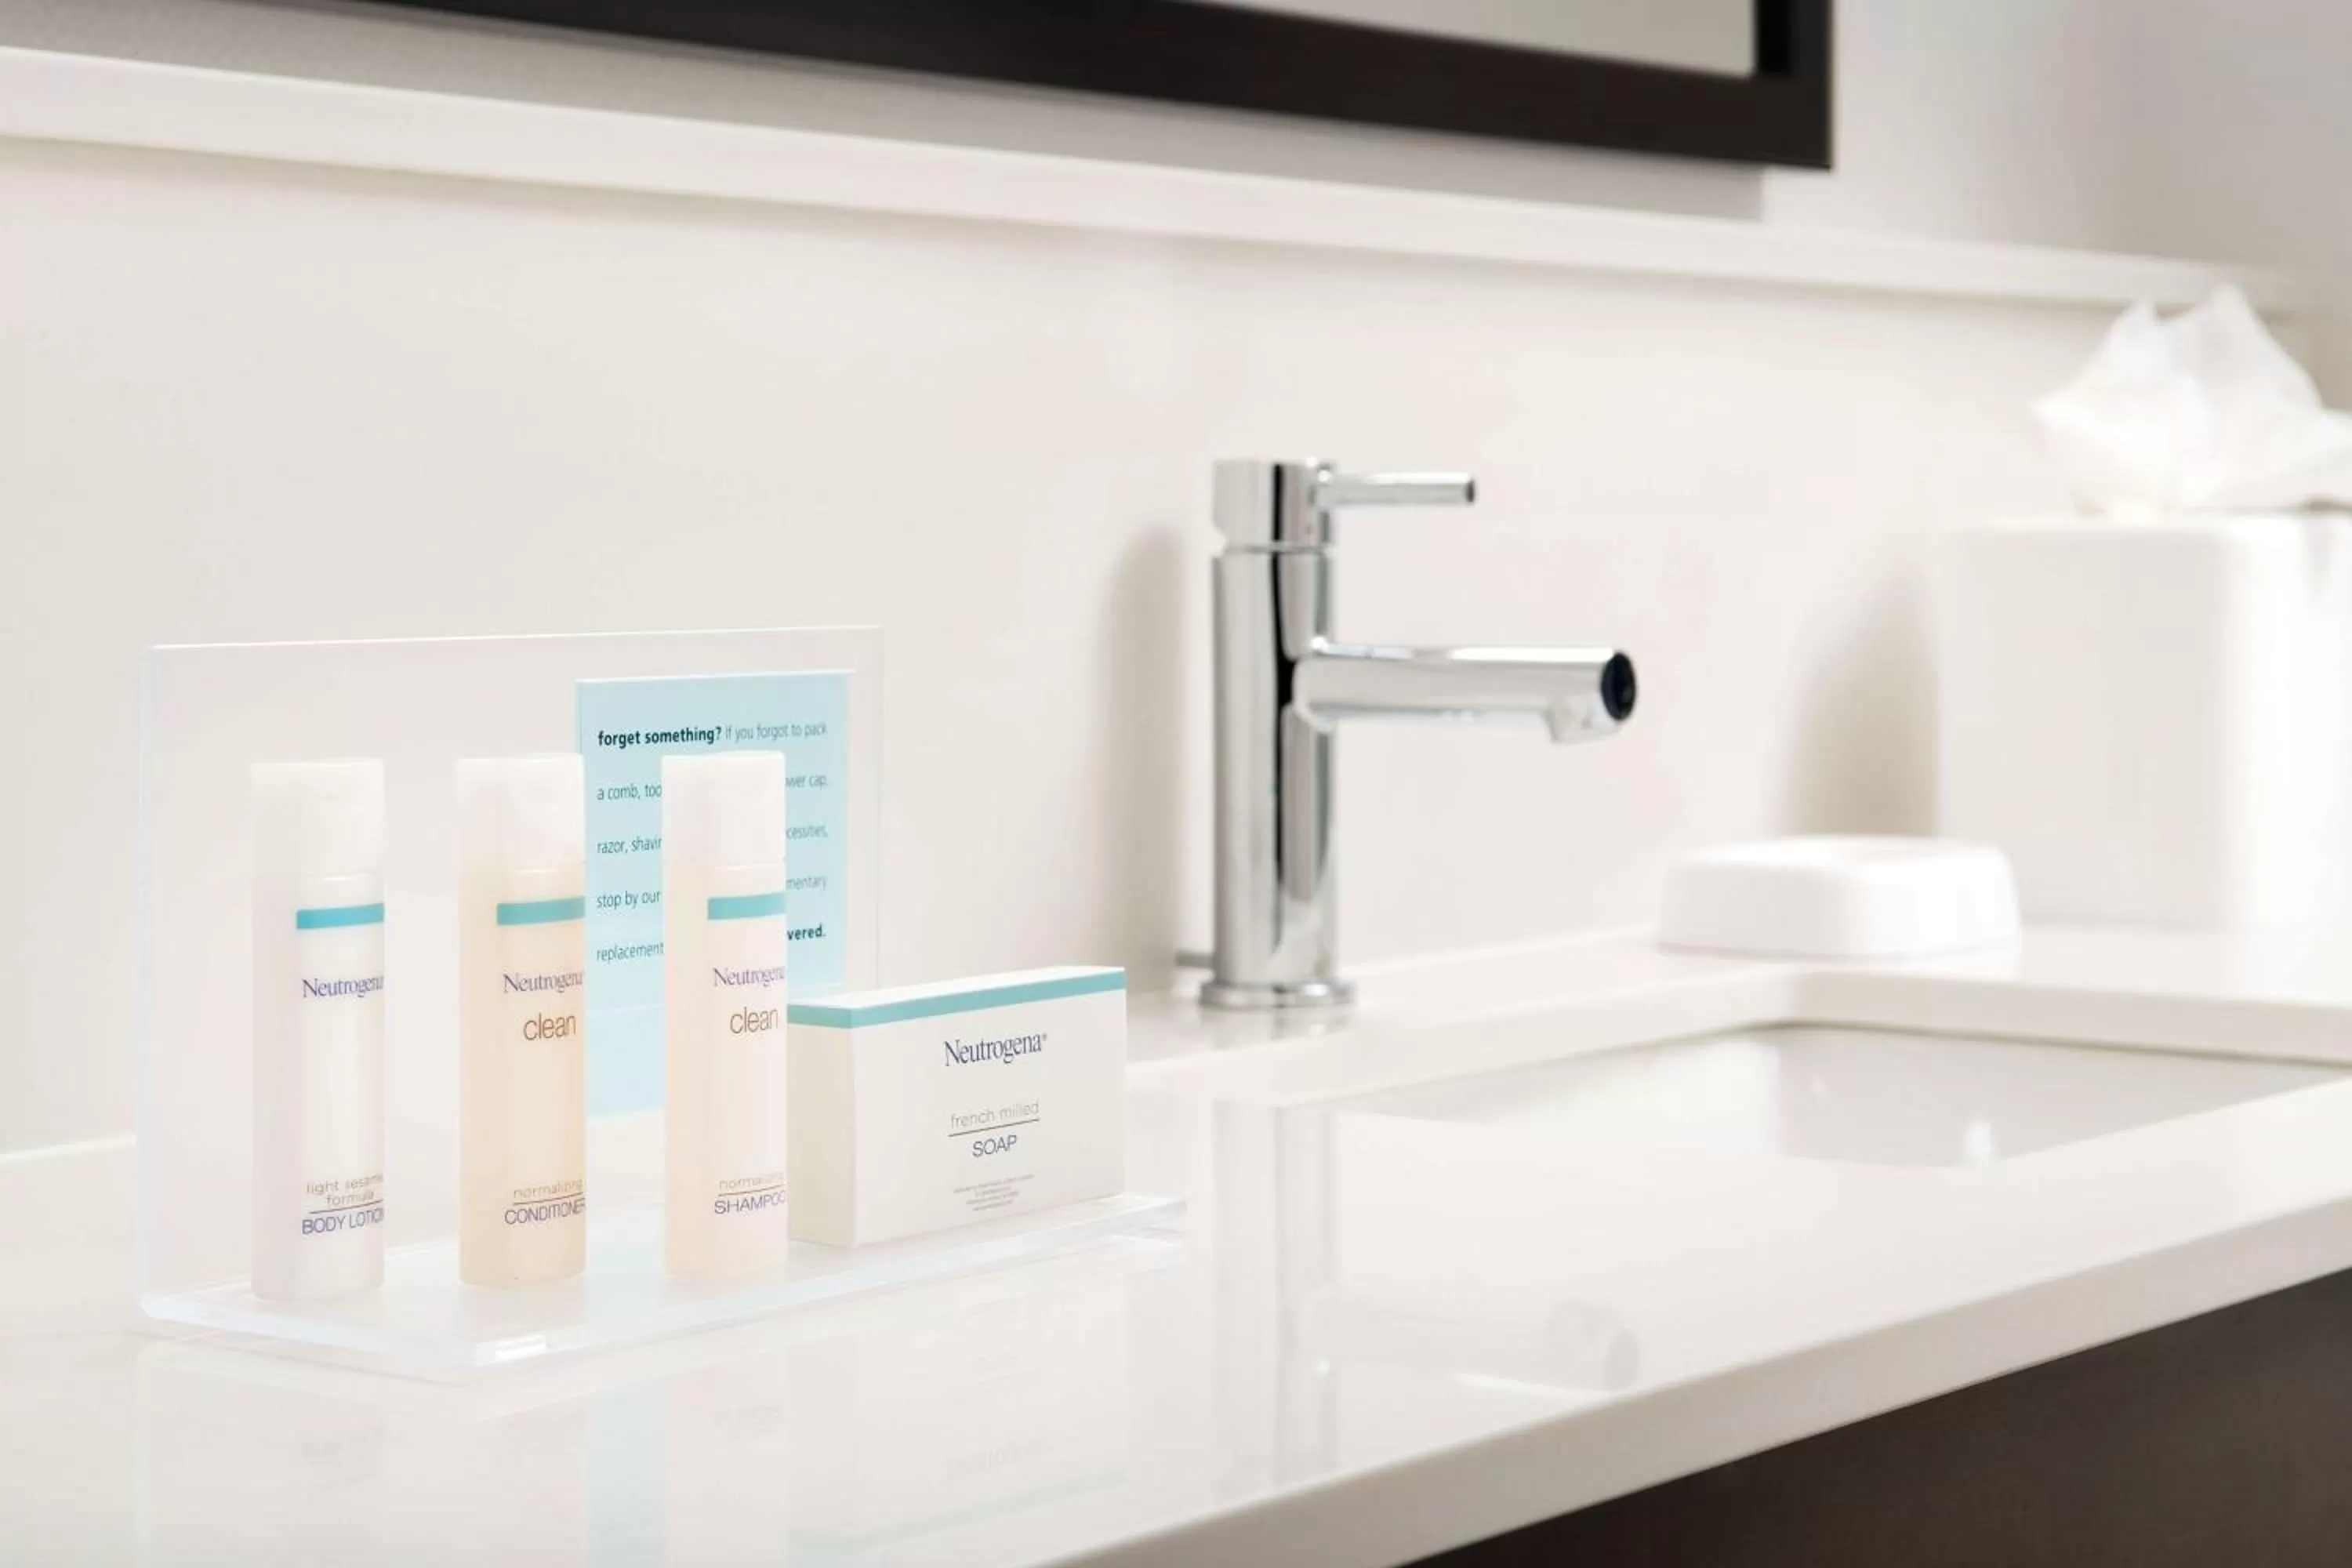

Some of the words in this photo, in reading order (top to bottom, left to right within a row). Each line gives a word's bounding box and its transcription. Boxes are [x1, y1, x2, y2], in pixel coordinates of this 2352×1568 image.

[598, 731, 641, 749] forget
[644, 725, 721, 745] something?
[725, 725, 732, 740] If
[735, 728, 753, 743] you
[757, 723, 788, 741] forgot
[791, 723, 802, 736] to
[804, 721, 827, 739] pack
[786, 775, 806, 789] wer
[597, 788, 604, 800] a
[608, 783, 641, 800] comb,
[644, 784, 662, 797] too
[786, 824, 828, 840] cessities,
[597, 840, 628, 854] razor,
[786, 875, 828, 891] mentary
[597, 895, 621, 909] stop
[625, 891, 639, 909] by
[642, 891, 661, 903] our
[786, 922, 826, 940] vered.
[597, 942, 664, 963] replacement
[523, 1012, 575, 1040] clean
[730, 1007, 779, 1034] clean
[950, 1107, 995, 1129] french
[1000, 1099, 1040, 1119] milled
[972, 1134, 1018, 1158] SOAP
[307, 1178, 339, 1196] light
[326, 1190, 373, 1206] formula
[302, 1214, 346, 1235] BODY
